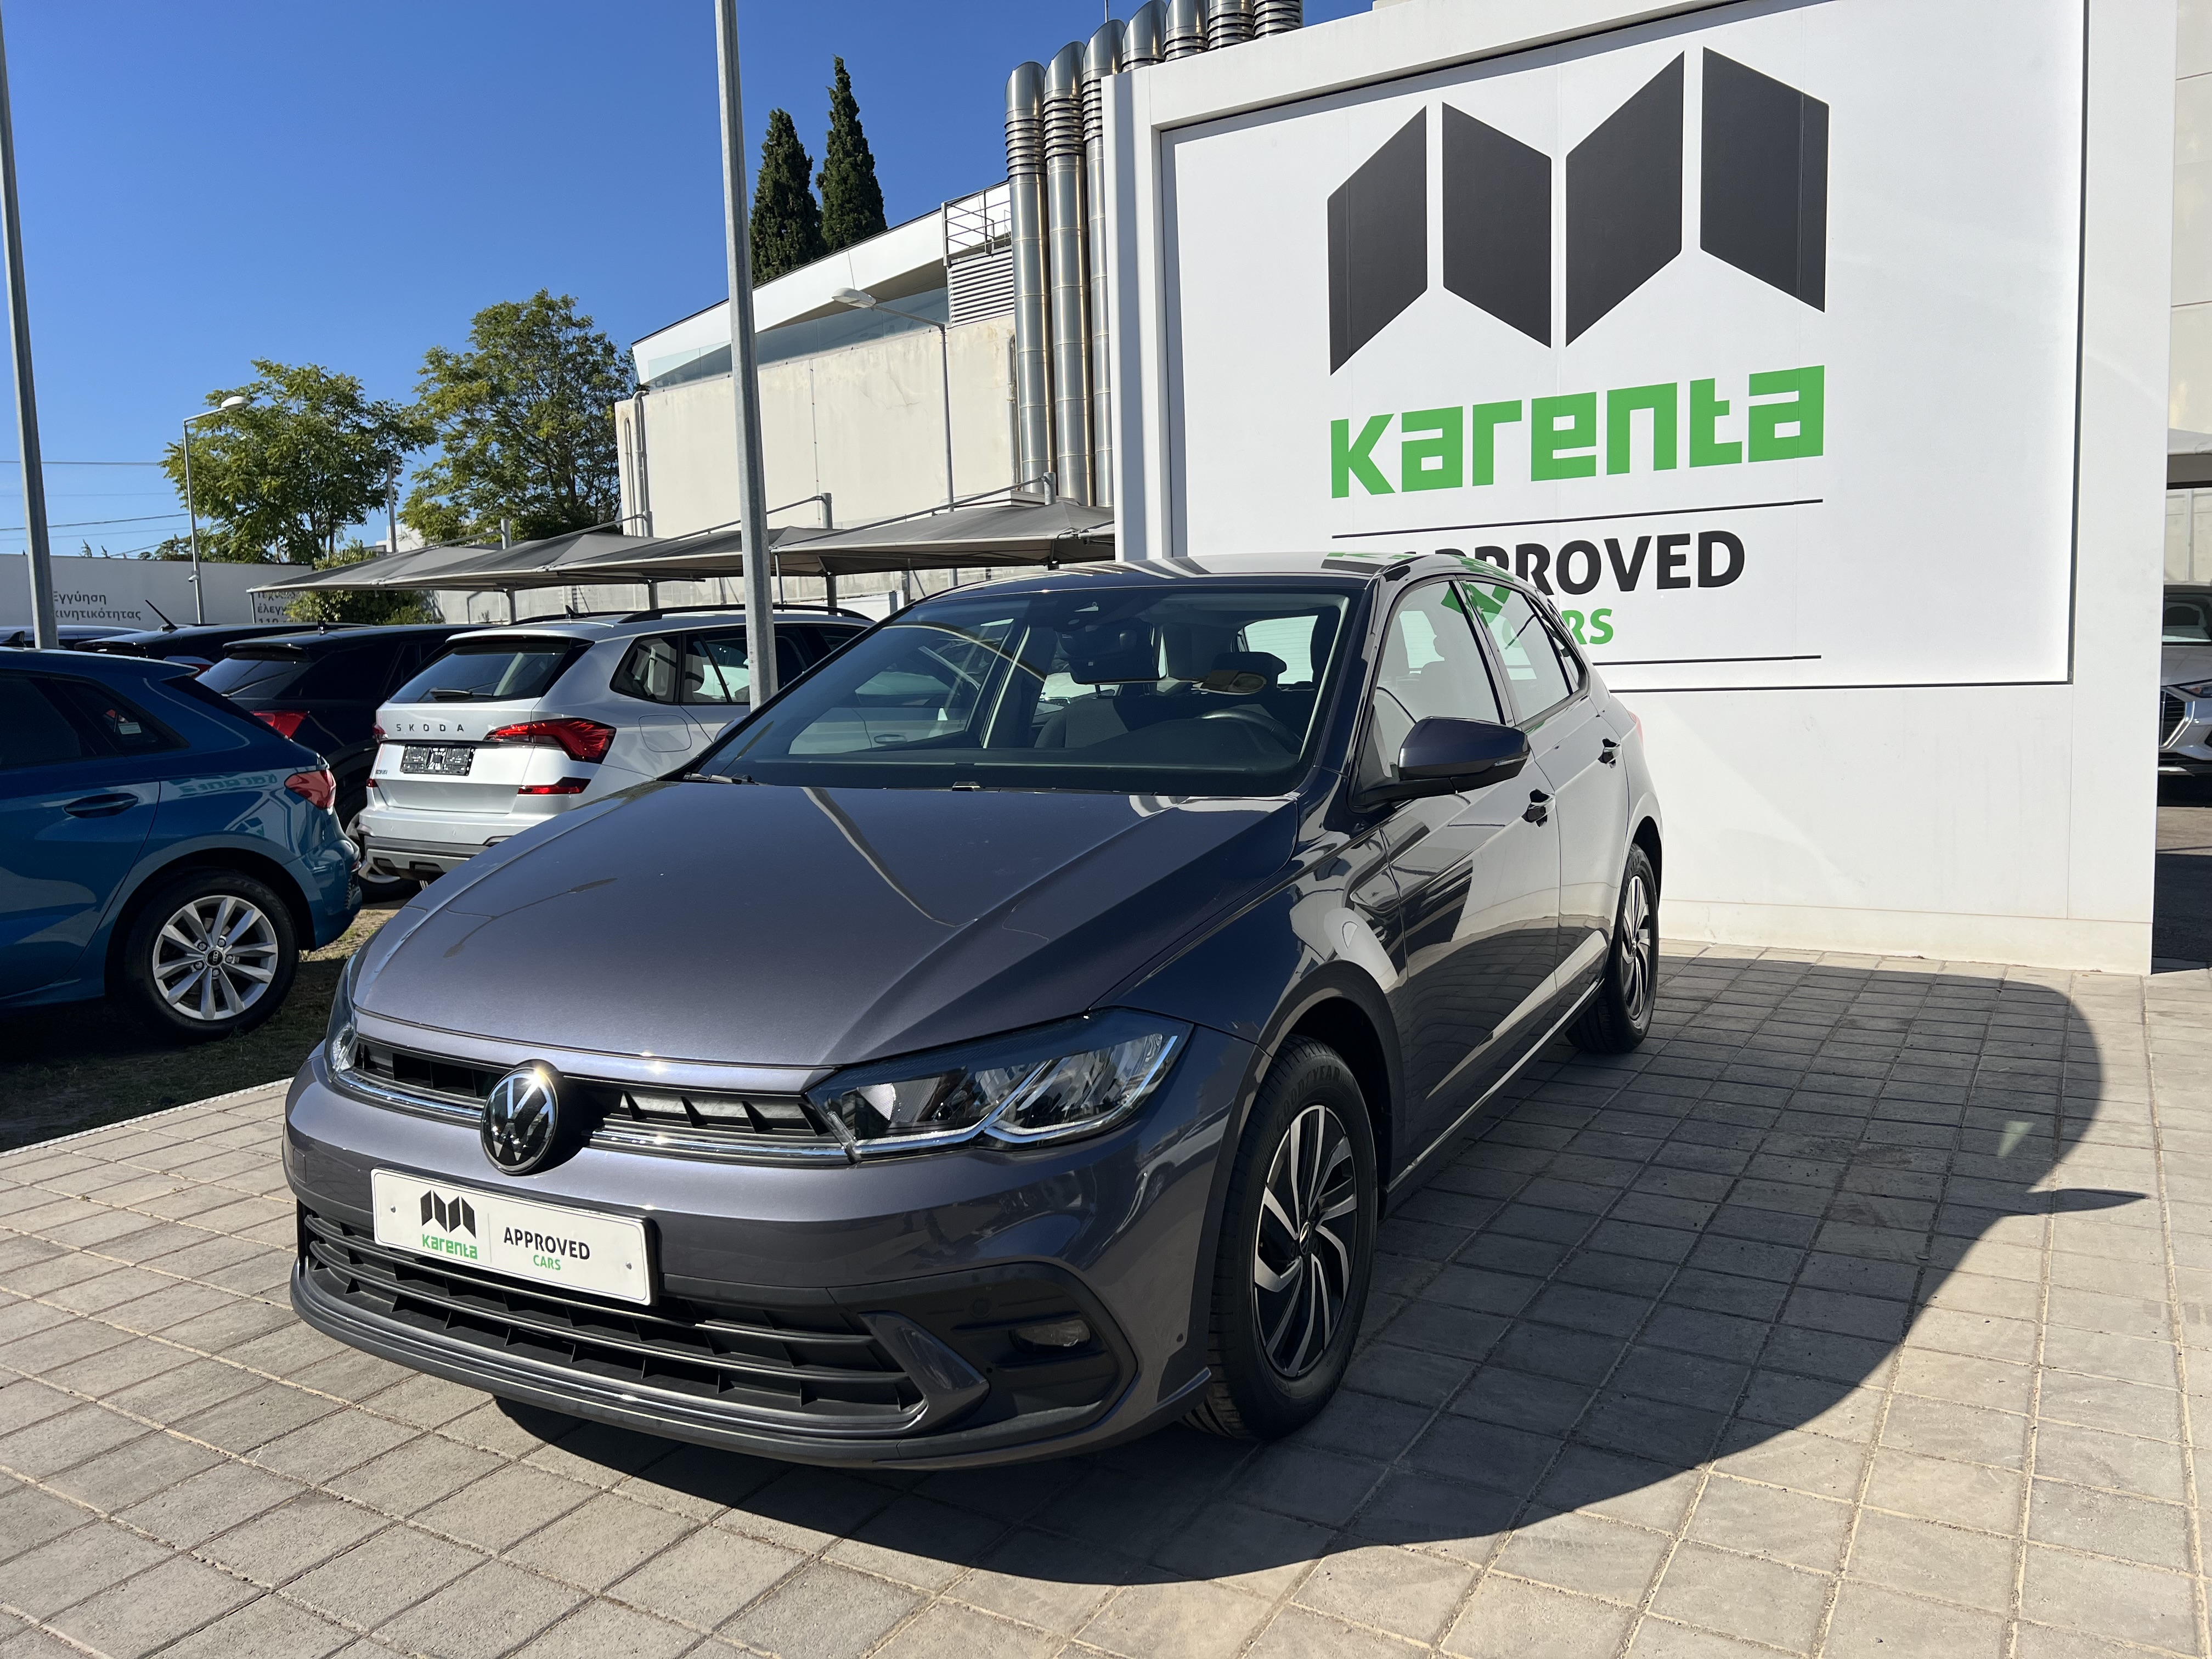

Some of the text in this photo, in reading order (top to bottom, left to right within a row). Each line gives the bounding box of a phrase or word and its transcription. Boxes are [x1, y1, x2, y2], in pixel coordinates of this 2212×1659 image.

[1404, 530, 1745, 595] PROVED
[396, 724, 464, 732] SKODA
[504, 1226, 590, 1260] APPROVED
[533, 1254, 561, 1271] CARS
